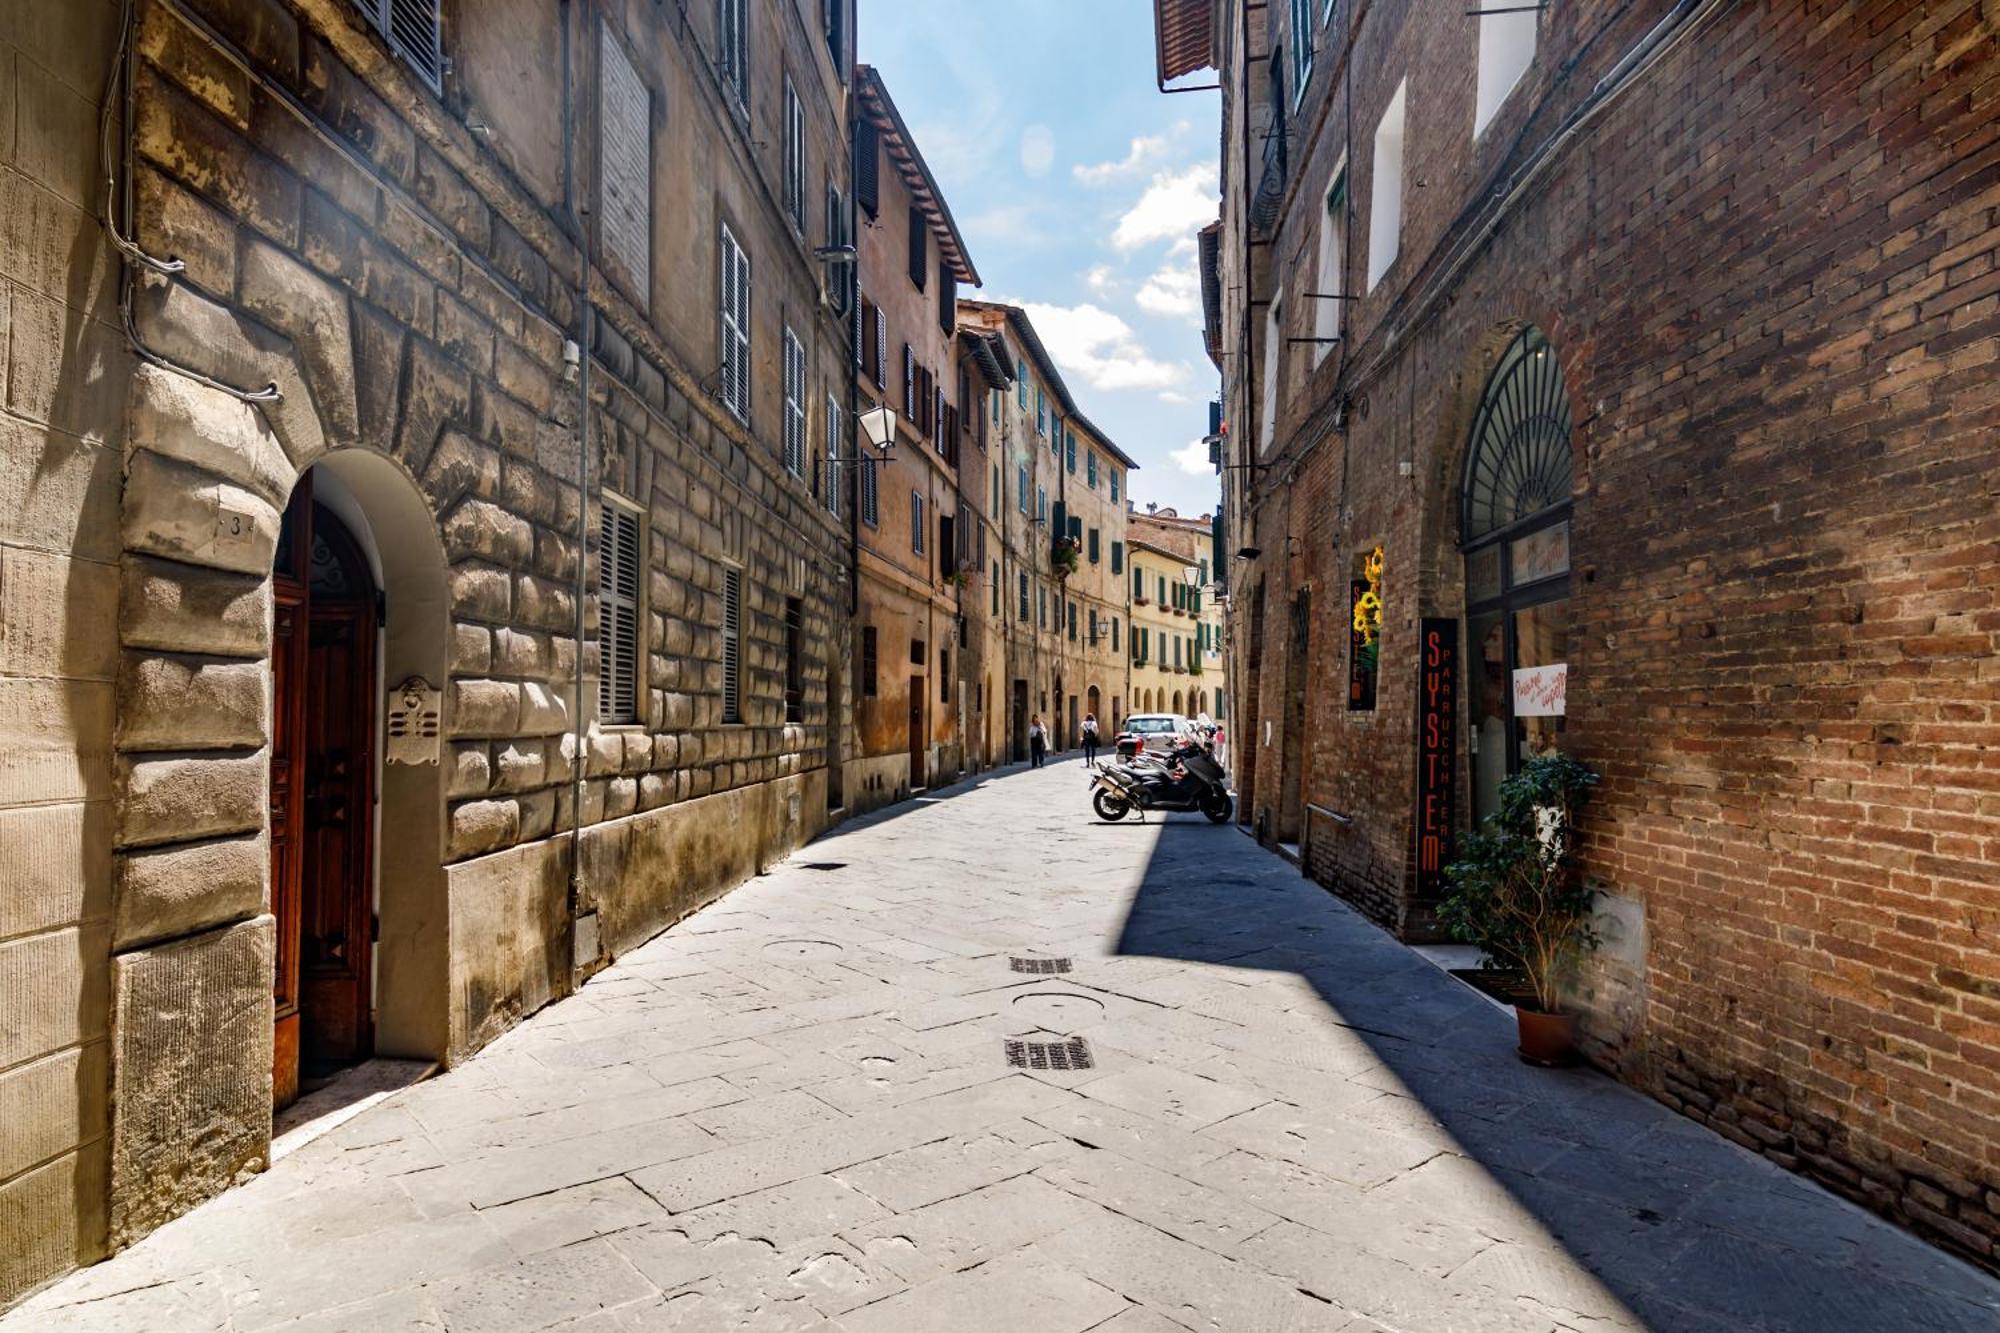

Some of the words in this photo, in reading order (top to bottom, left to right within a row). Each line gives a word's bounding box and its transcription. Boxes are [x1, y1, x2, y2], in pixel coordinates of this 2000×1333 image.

[231, 517, 240, 535] 3
[1422, 631, 1440, 872] SYSTEM
[1440, 648, 1451, 855] PARRUCCHIERE
